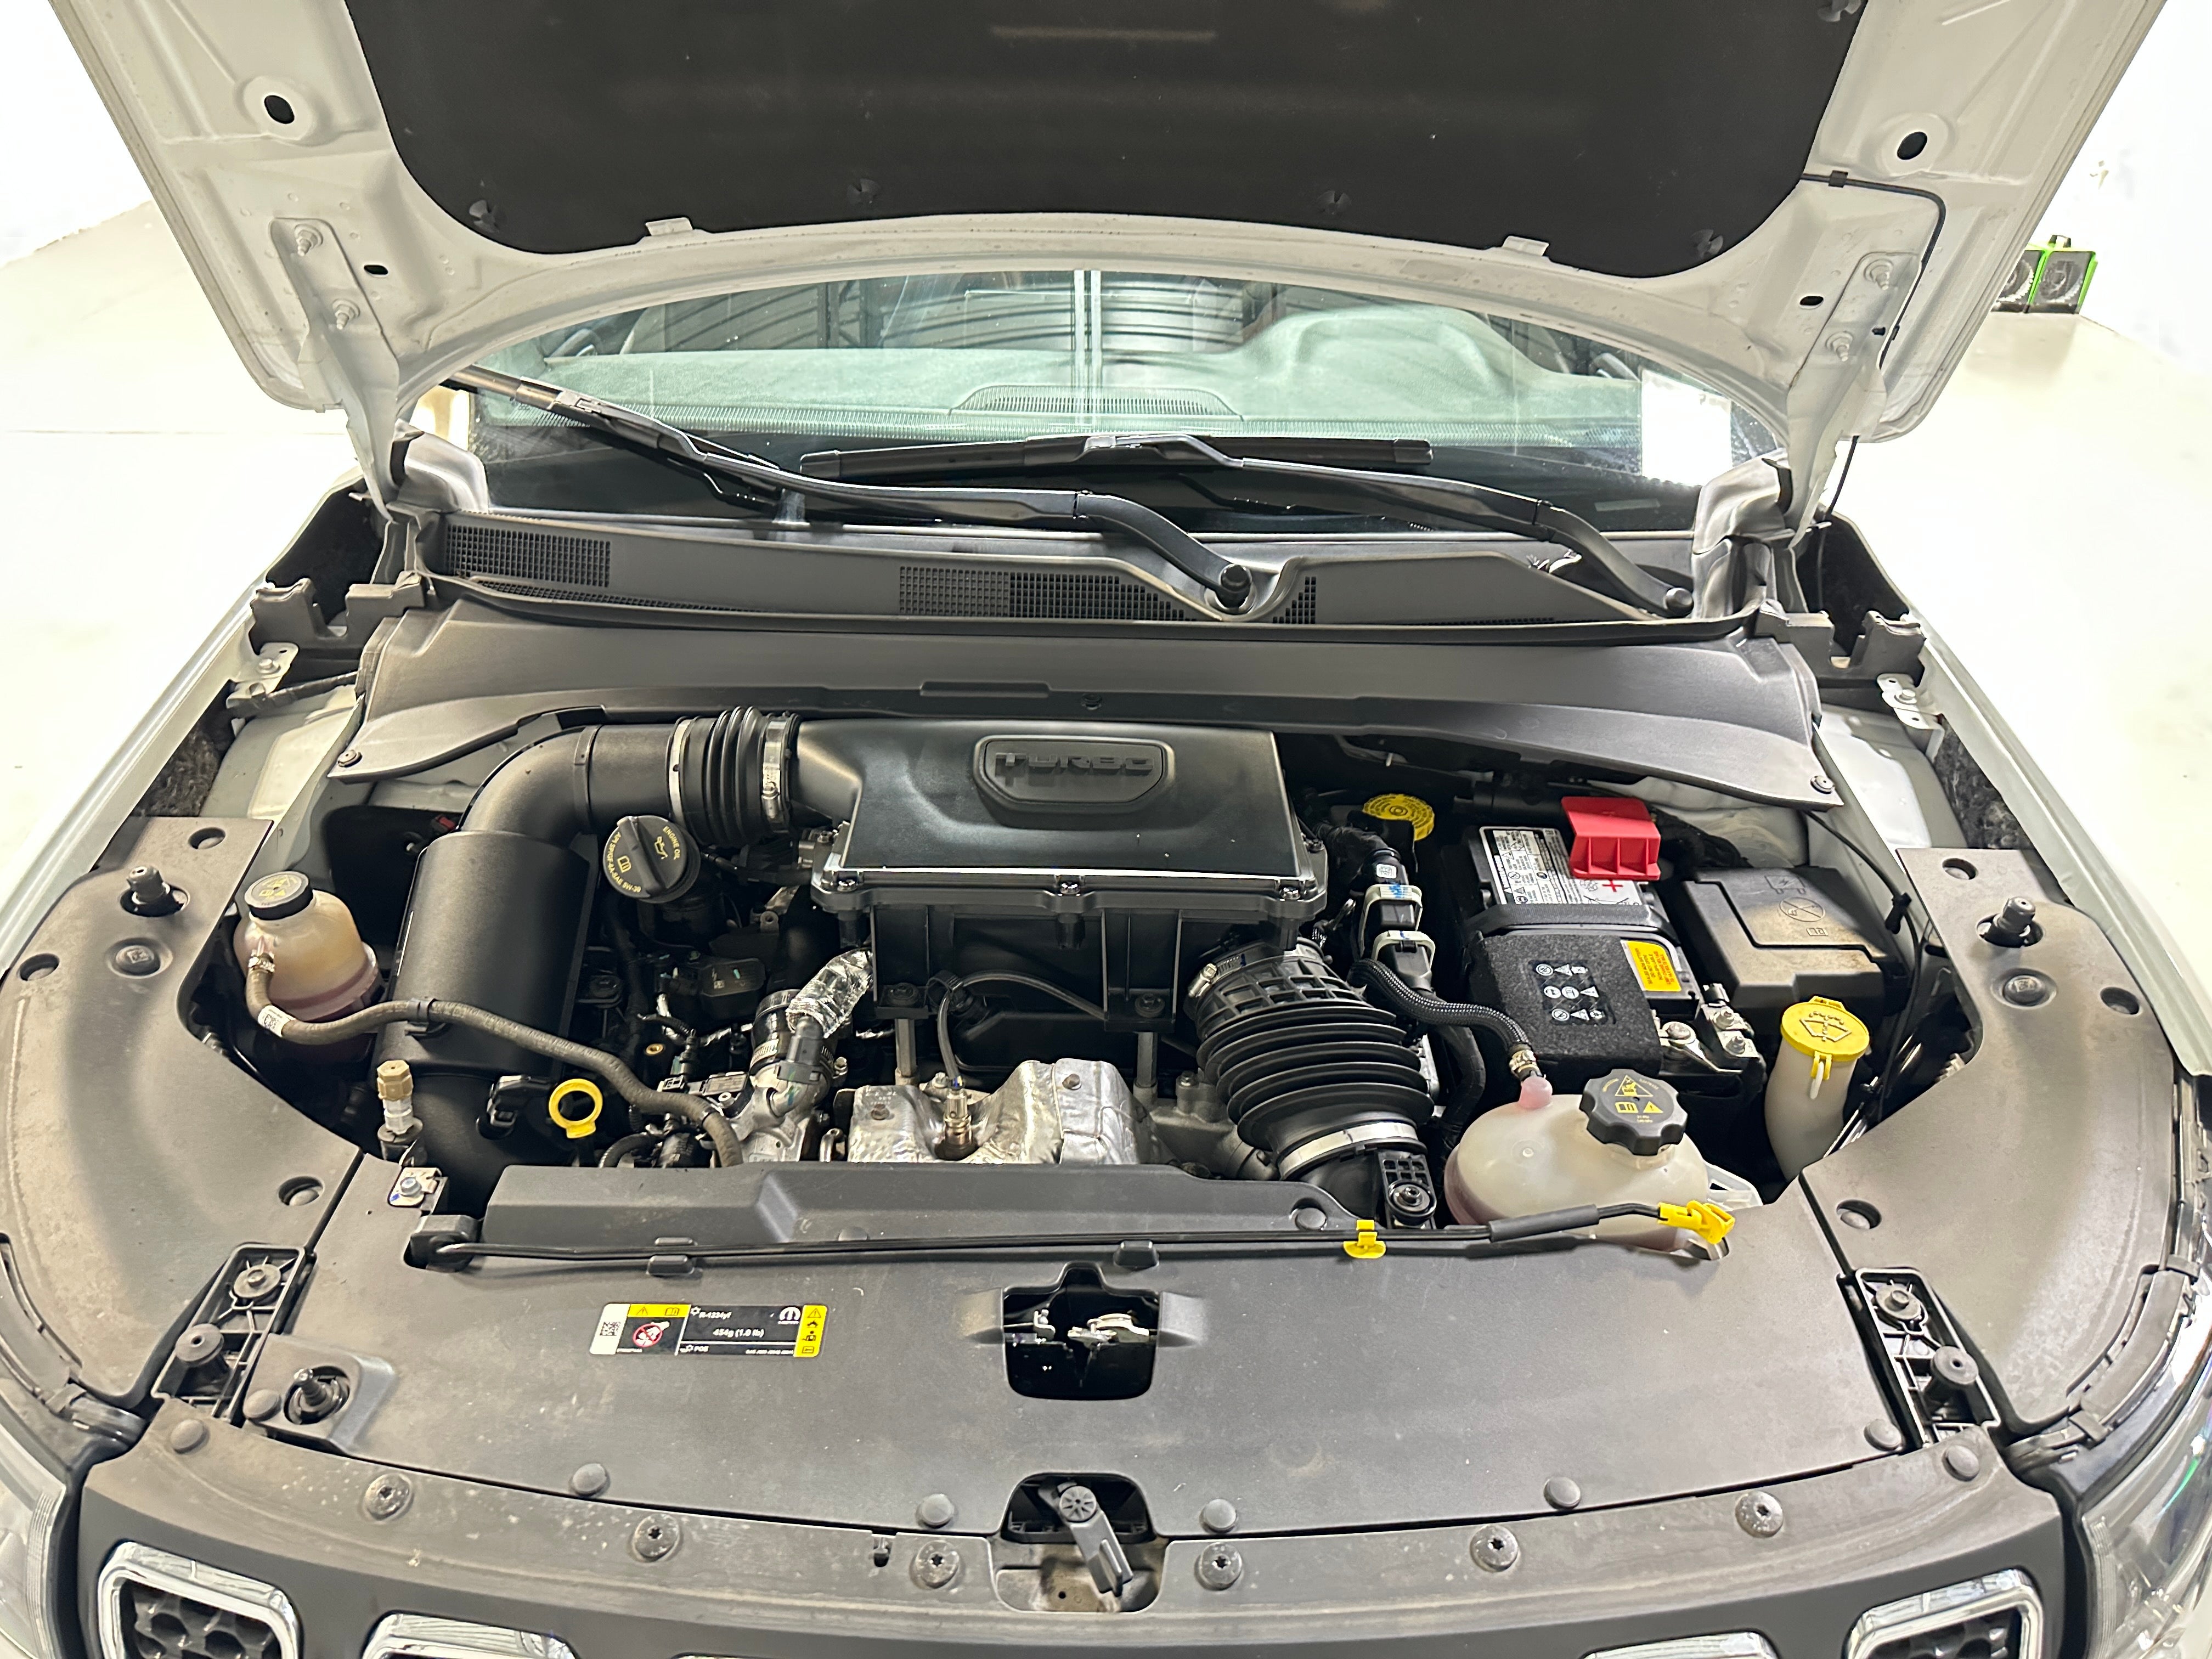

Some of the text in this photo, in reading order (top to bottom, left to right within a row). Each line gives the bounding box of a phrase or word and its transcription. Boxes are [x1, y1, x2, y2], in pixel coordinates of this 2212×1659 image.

[995, 752, 1154, 775] TURBO
[663, 825, 680, 849] ENGINE
[713, 1329, 765, 1338] 454g (1.0 lb)
